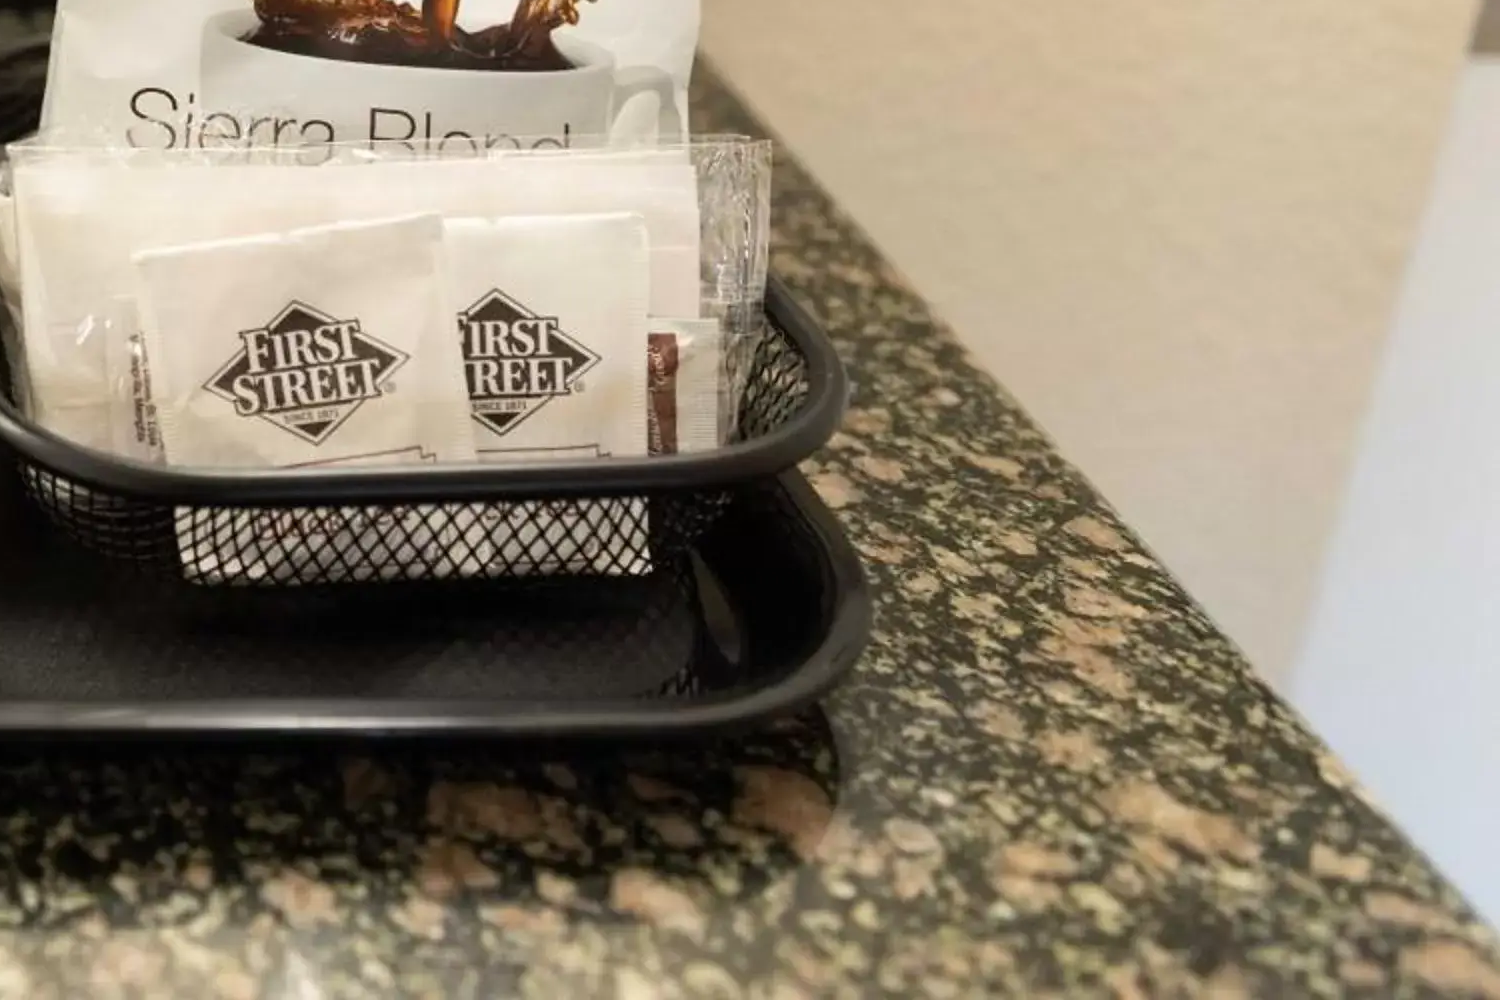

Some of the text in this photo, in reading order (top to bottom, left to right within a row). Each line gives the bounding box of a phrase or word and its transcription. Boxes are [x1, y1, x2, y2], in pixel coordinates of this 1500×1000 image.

[126, 86, 336, 167] Sierra
[243, 320, 361, 374] FIRST
[233, 358, 381, 415] STREET
[465, 357, 573, 398] REET
